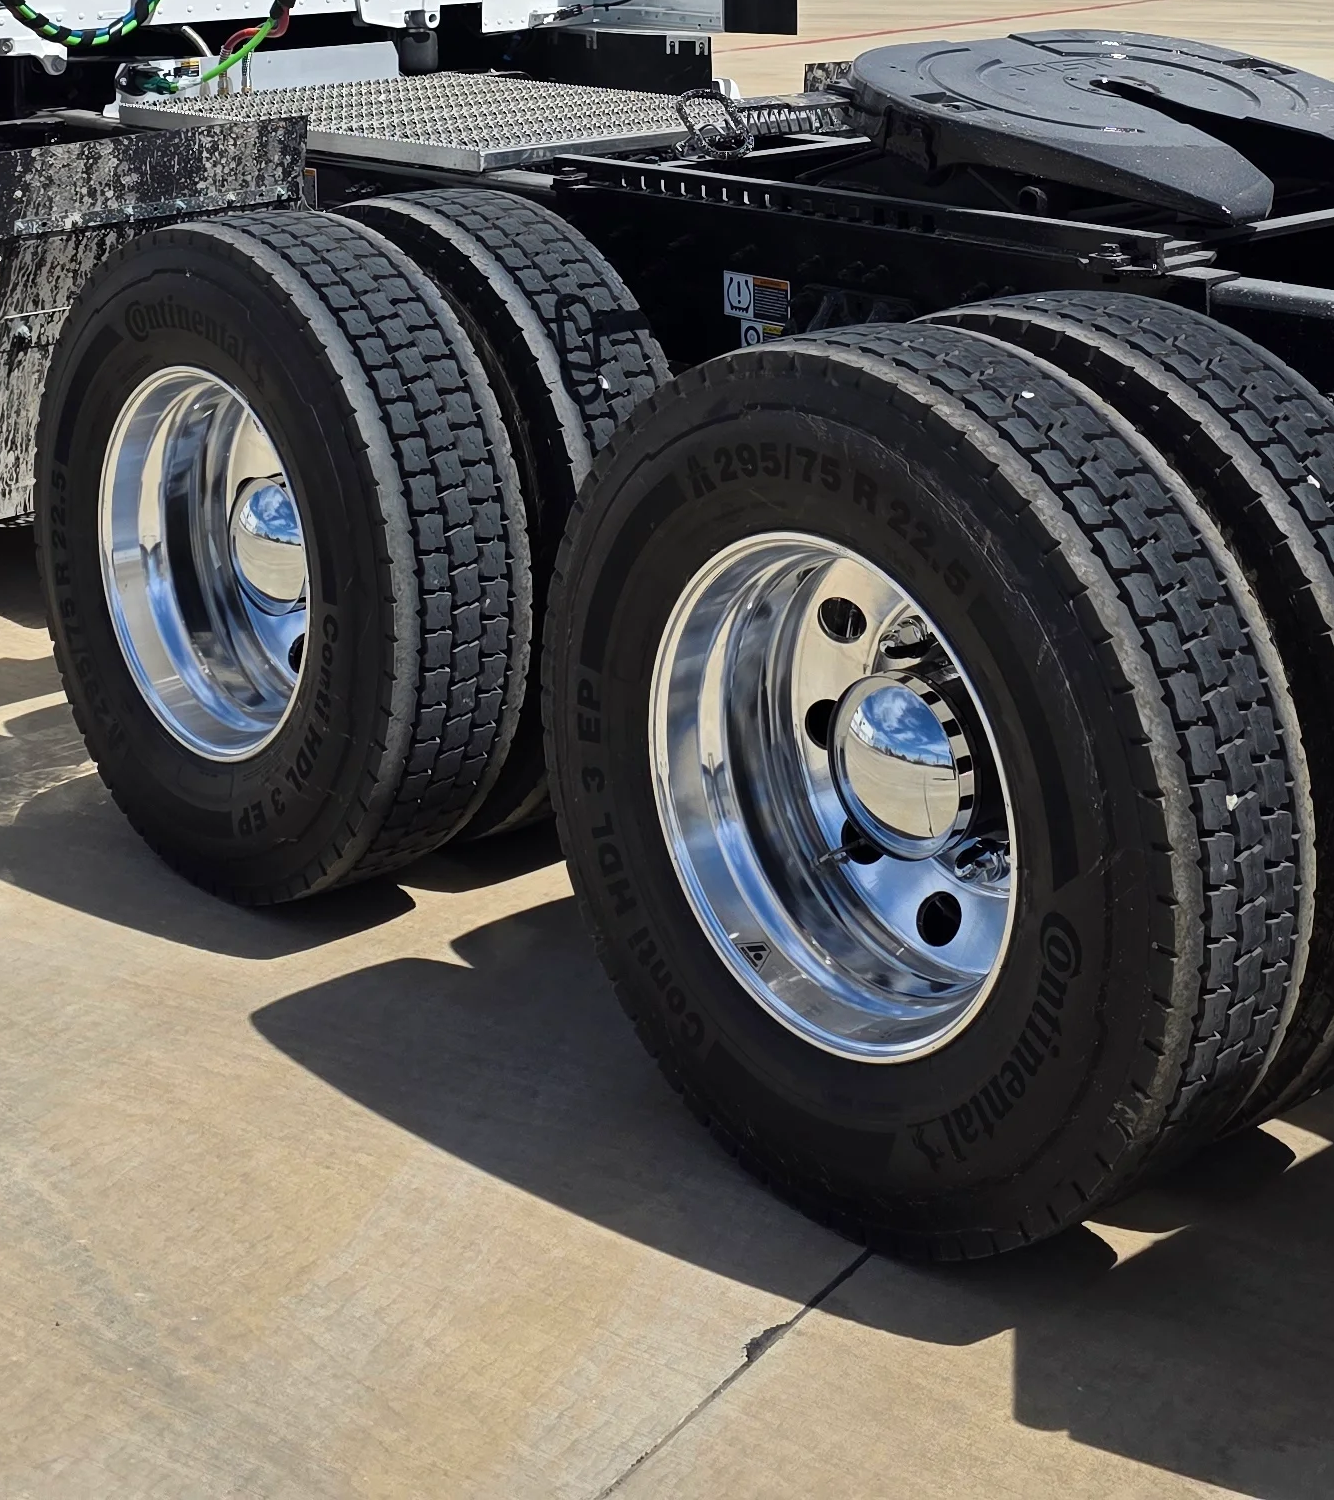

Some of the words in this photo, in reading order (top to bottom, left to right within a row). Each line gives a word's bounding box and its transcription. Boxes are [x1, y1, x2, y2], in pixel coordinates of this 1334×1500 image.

[124, 293, 248, 372] Continental
[852, 468, 879, 515] R
[886, 500, 972, 597] 22.5
[313, 613, 340, 726] Conti
[577, 686, 603, 745] EP
[284, 724, 324, 794] HDL
[581, 765, 606, 794] 3
[236, 799, 269, 838] EP
[270, 786, 287, 817] 3
[590, 811, 639, 919] HDL
[627, 925, 706, 1049] Conti
[944, 910, 1083, 1163] Continental
